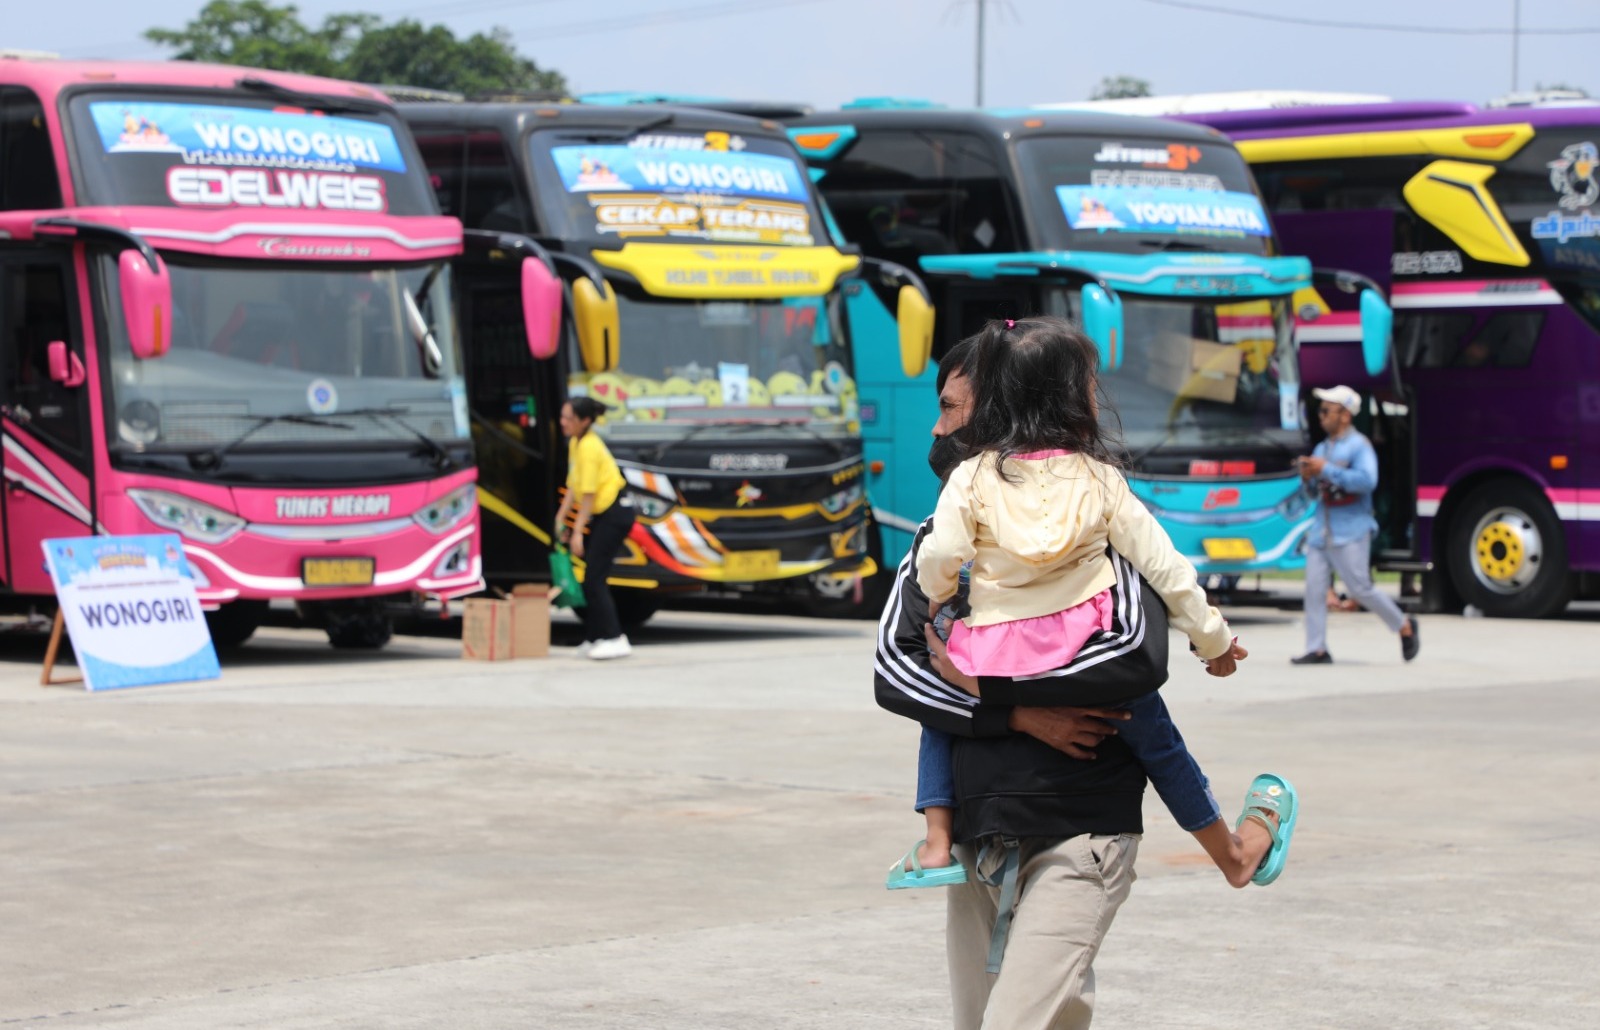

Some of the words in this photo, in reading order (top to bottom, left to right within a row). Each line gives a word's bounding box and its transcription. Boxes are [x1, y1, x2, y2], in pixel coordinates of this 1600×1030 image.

[194, 121, 381, 164] WONOGIRI
[167, 167, 386, 213] EDELWEIS
[636, 160, 789, 194] WONOGIRI
[598, 205, 698, 224] CEKAP
[703, 208, 806, 231] TERANG
[1126, 202, 1264, 231] YOGYAKARTA
[275, 496, 329, 518] TUNAS
[79, 598, 195, 628] WONOGIRI
